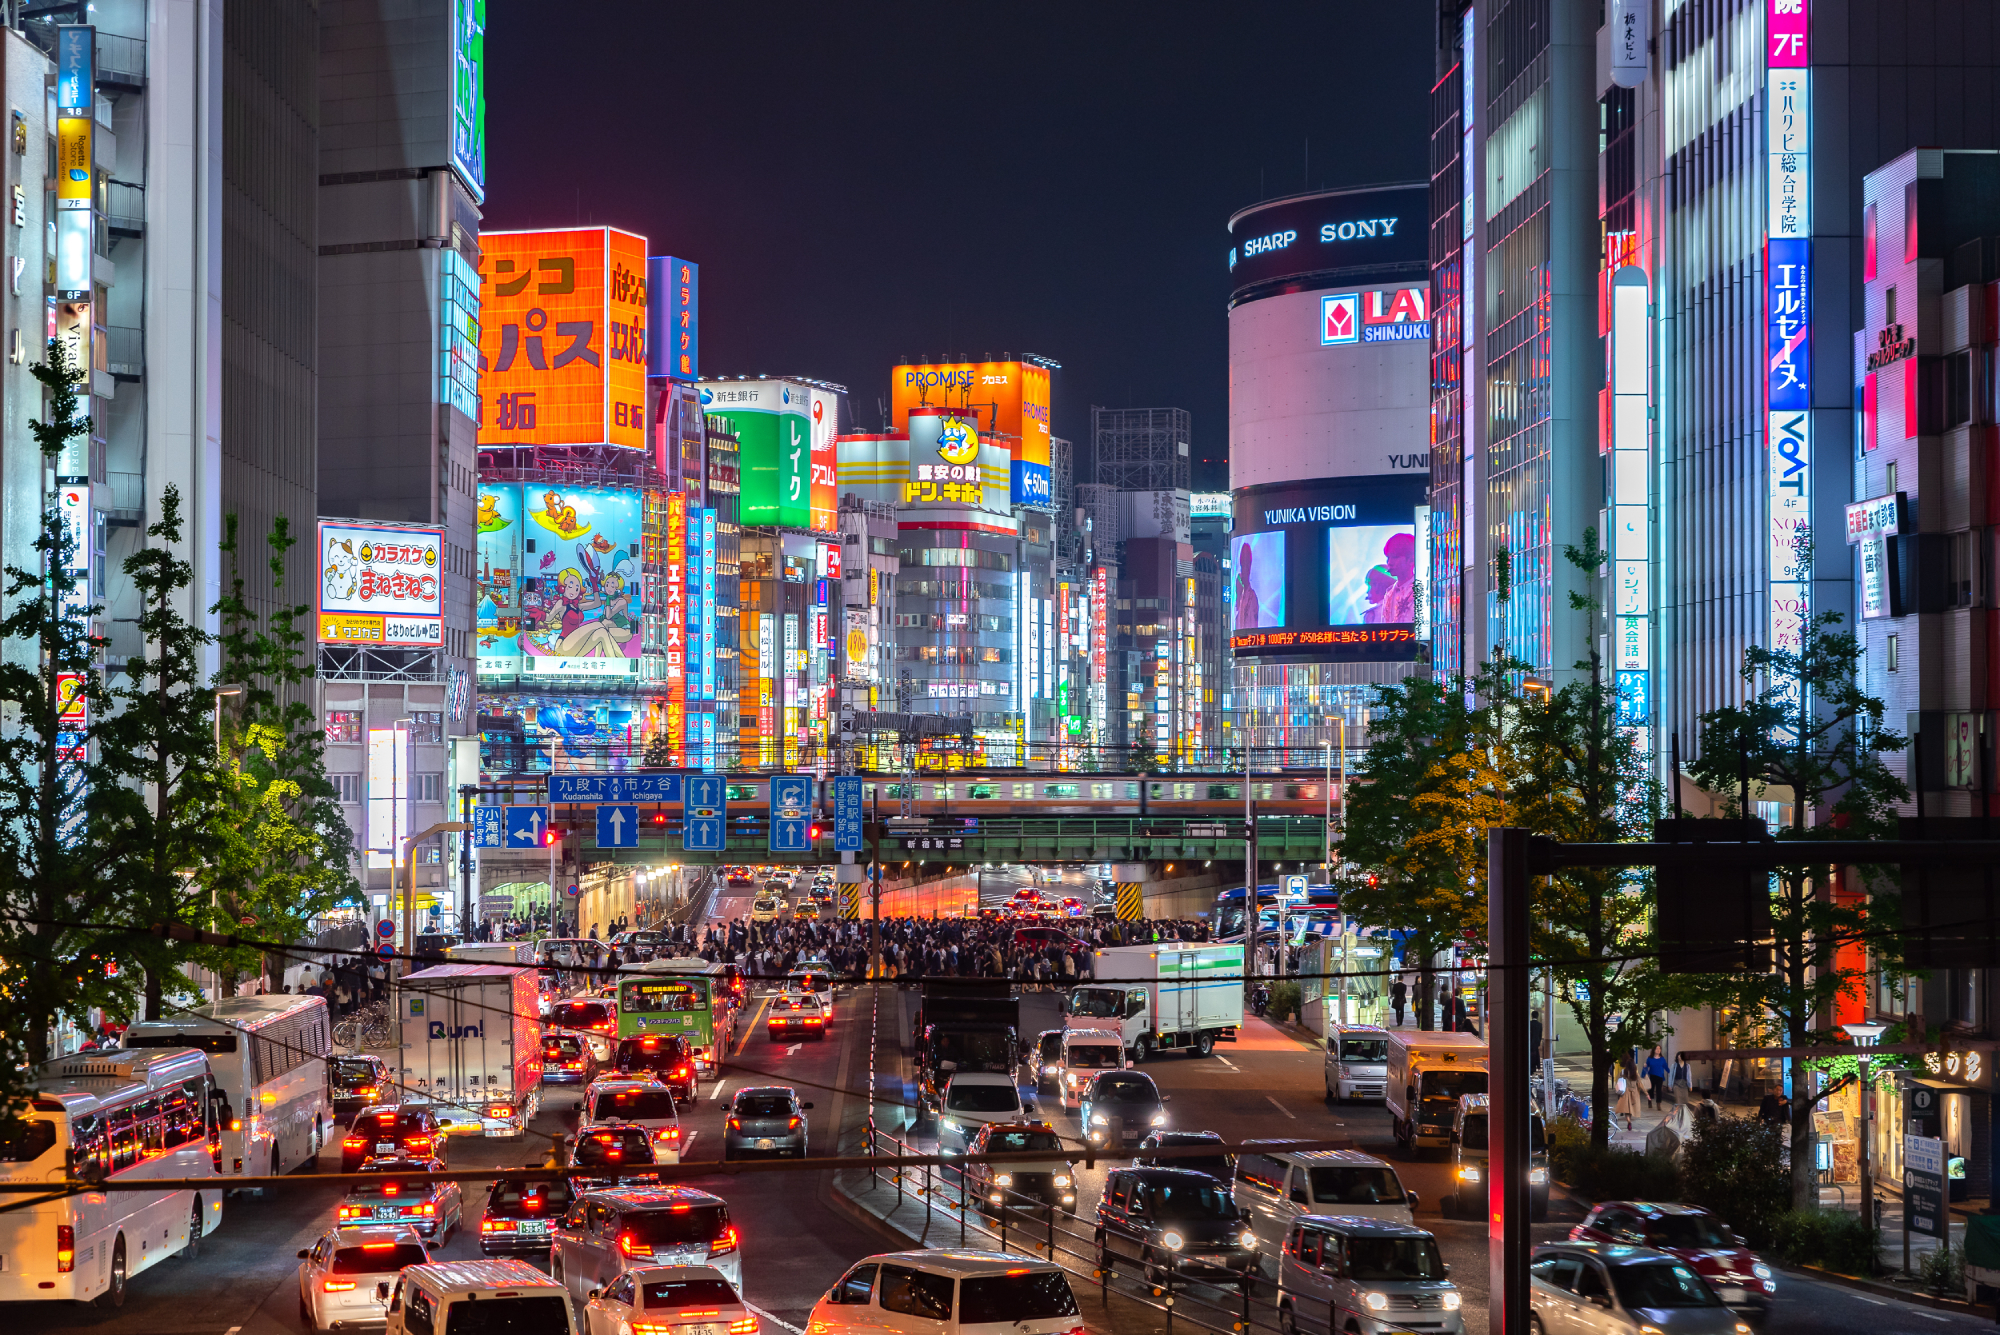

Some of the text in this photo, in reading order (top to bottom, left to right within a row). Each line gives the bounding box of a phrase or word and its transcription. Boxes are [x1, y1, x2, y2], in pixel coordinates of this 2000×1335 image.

[1624, 12, 1636, 61] 栃木ビル
[1773, 34, 1803, 57] 7F
[78, 135, 86, 167] Rosetta
[1781, 95, 1797, 234] ハクビ総合学院
[1244, 217, 1398, 257] SHARP SONY
[67, 290, 81, 299] 6F
[612, 262, 647, 308] パチンコ
[1364, 287, 1430, 325] LA
[680, 265, 691, 374] カラオケ館
[1774, 264, 1801, 390] エルセーヌ
[478, 308, 600, 372] パス
[611, 316, 647, 366] エスパス
[1364, 323, 1430, 343] SHINJUKU
[905, 369, 974, 388] PROMISE
[981, 375, 1008, 386] プロミス
[716, 390, 759, 402] 新生銀行
[1023, 400, 1048, 424] PROMISE
[790, 420, 801, 501] レイク
[811, 463, 835, 486] アコム
[1032, 473, 1048, 496] 50m
[1265, 504, 1356, 525] YUNIKA VISION
[1783, 499, 1797, 509] 4F
[669, 500, 681, 560] パチンコ
[819, 519, 828, 529] 3F
[1773, 517, 1808, 530] NOA
[374, 545, 423, 563] カラオケ
[1865, 553, 1883, 574] 歯科
[360, 567, 437, 601] まねきねこ
[1099, 572, 1107, 609] カラオケ
[669, 564, 680, 646] エスパス
[1772, 599, 1809, 612] NOA
[342, 627, 381, 640] ワンカラ
[386, 623, 422, 638] となりのビル
[429, 624, 439, 638] 4F
[761, 624, 769, 669] 小松ビル
[485, 660, 512, 669] 北電子
[582, 660, 606, 670] 北電子
[1633, 673, 1646, 721] ベースボール
[558, 777, 608, 792] 九段下
[613, 783, 619, 793] 4
[562, 792, 663, 801] Kudanshita Ichigaya
[837, 782, 847, 816] Shinjuku
[847, 780, 859, 847] 新宿駅東口
[475, 808, 484, 846] Otaki Brdg.
[485, 808, 500, 847] 小滝橋
[907, 839, 945, 849] 新宿駅
[418, 1075, 498, 1087] 九州運輸
